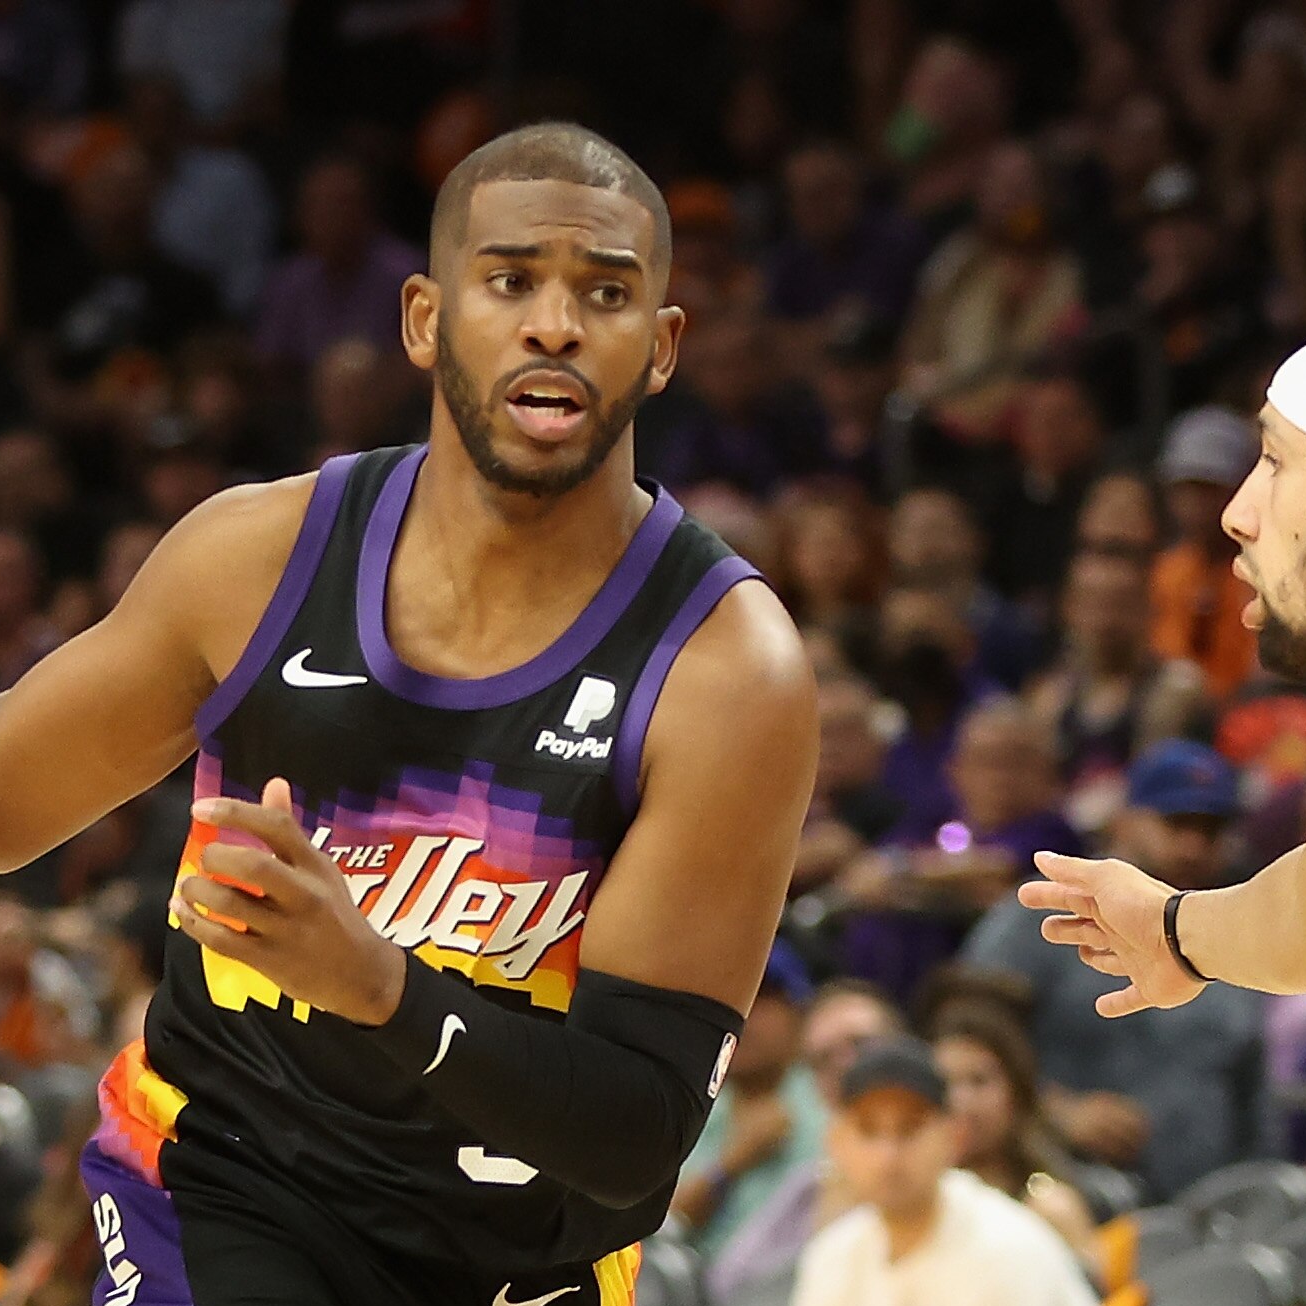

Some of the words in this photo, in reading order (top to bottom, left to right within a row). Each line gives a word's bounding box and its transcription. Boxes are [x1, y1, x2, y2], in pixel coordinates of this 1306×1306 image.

[534, 730, 613, 760] PayPal
[328, 844, 394, 868] THE
[310, 827, 589, 980] lley
